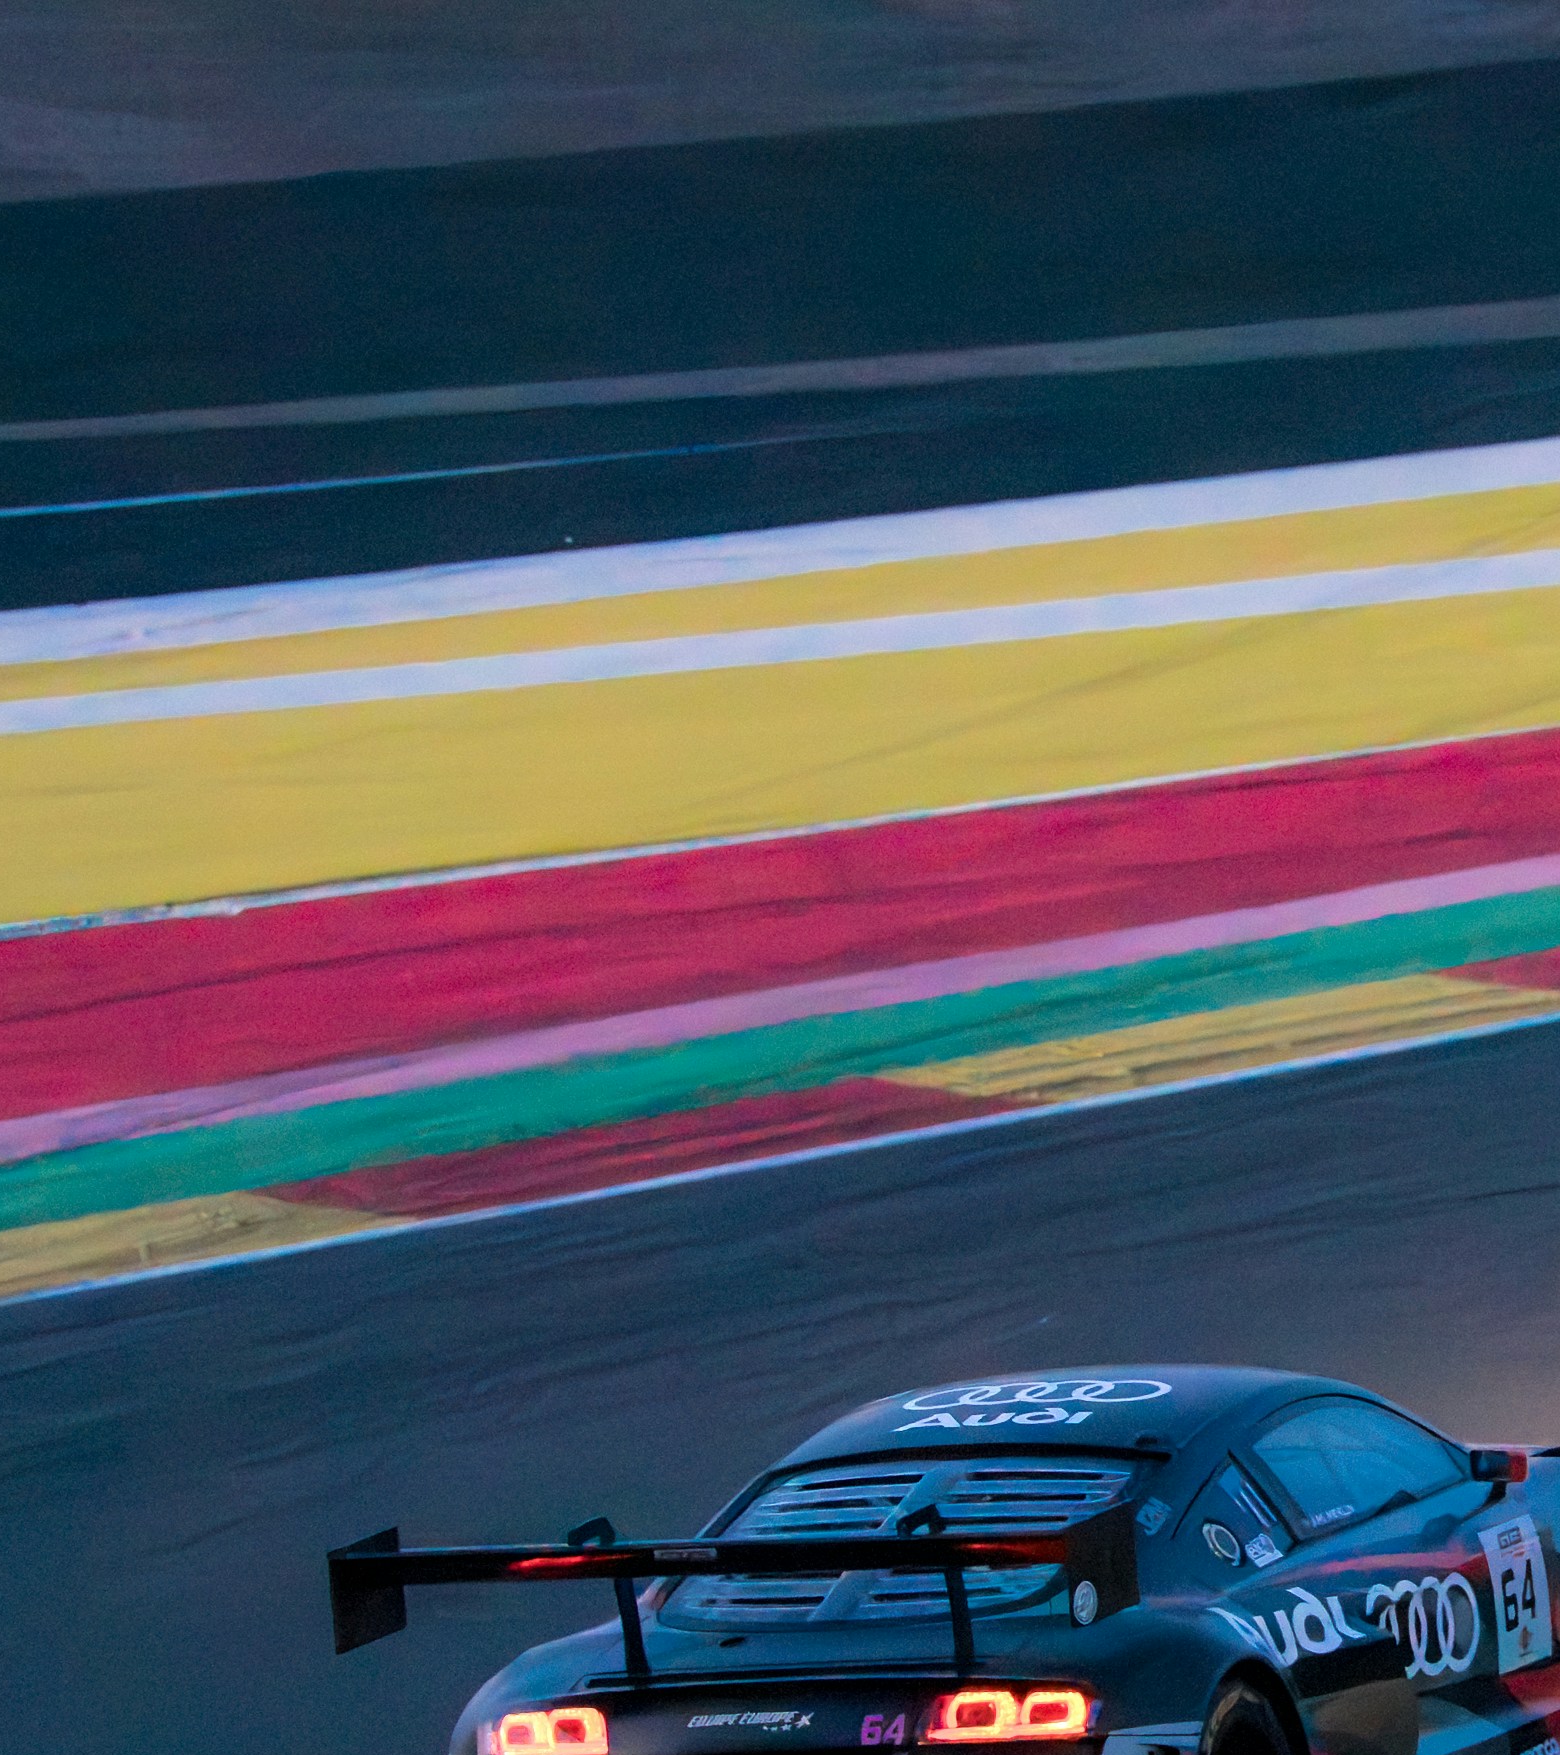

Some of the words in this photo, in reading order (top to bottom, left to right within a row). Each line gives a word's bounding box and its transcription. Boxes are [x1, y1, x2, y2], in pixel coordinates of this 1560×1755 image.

[892, 1407, 1093, 1432] Audi
[1501, 1559, 1536, 1632] 64
[1207, 1587, 1366, 1667] Audi
[861, 1713, 905, 1745] 64
